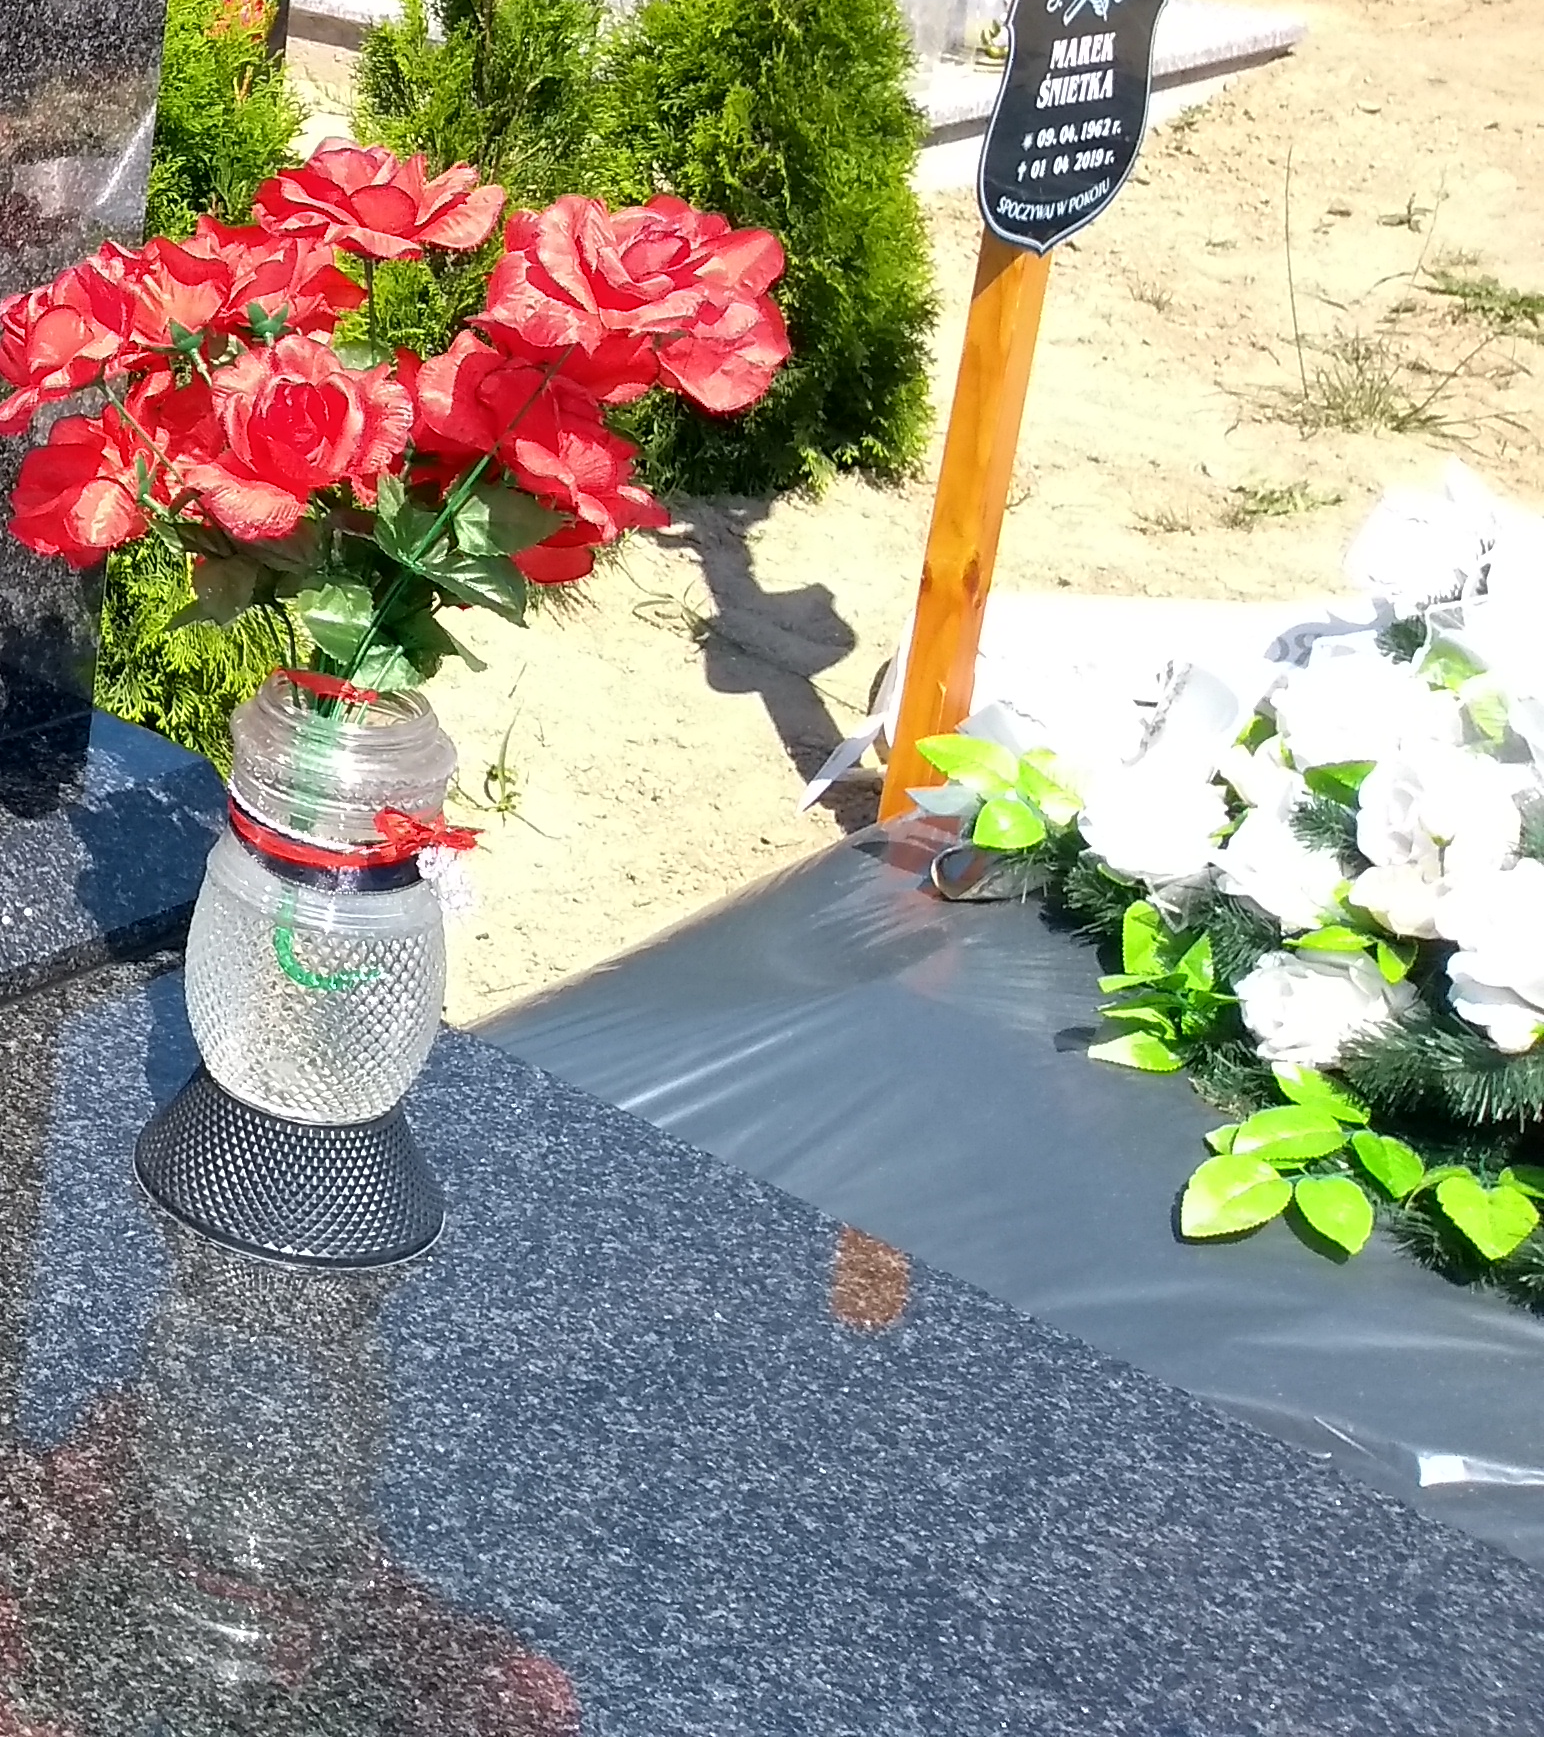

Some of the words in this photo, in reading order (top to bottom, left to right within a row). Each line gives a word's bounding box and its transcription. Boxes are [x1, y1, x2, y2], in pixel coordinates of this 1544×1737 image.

[1049, 31, 1117, 70] MAREK
[1035, 69, 1114, 109] ŚNIETKA
[996, 195, 1055, 222] SPOCZYWAJ
[1056, 199, 1069, 216] W
[1068, 176, 1110, 215] POKOJU
